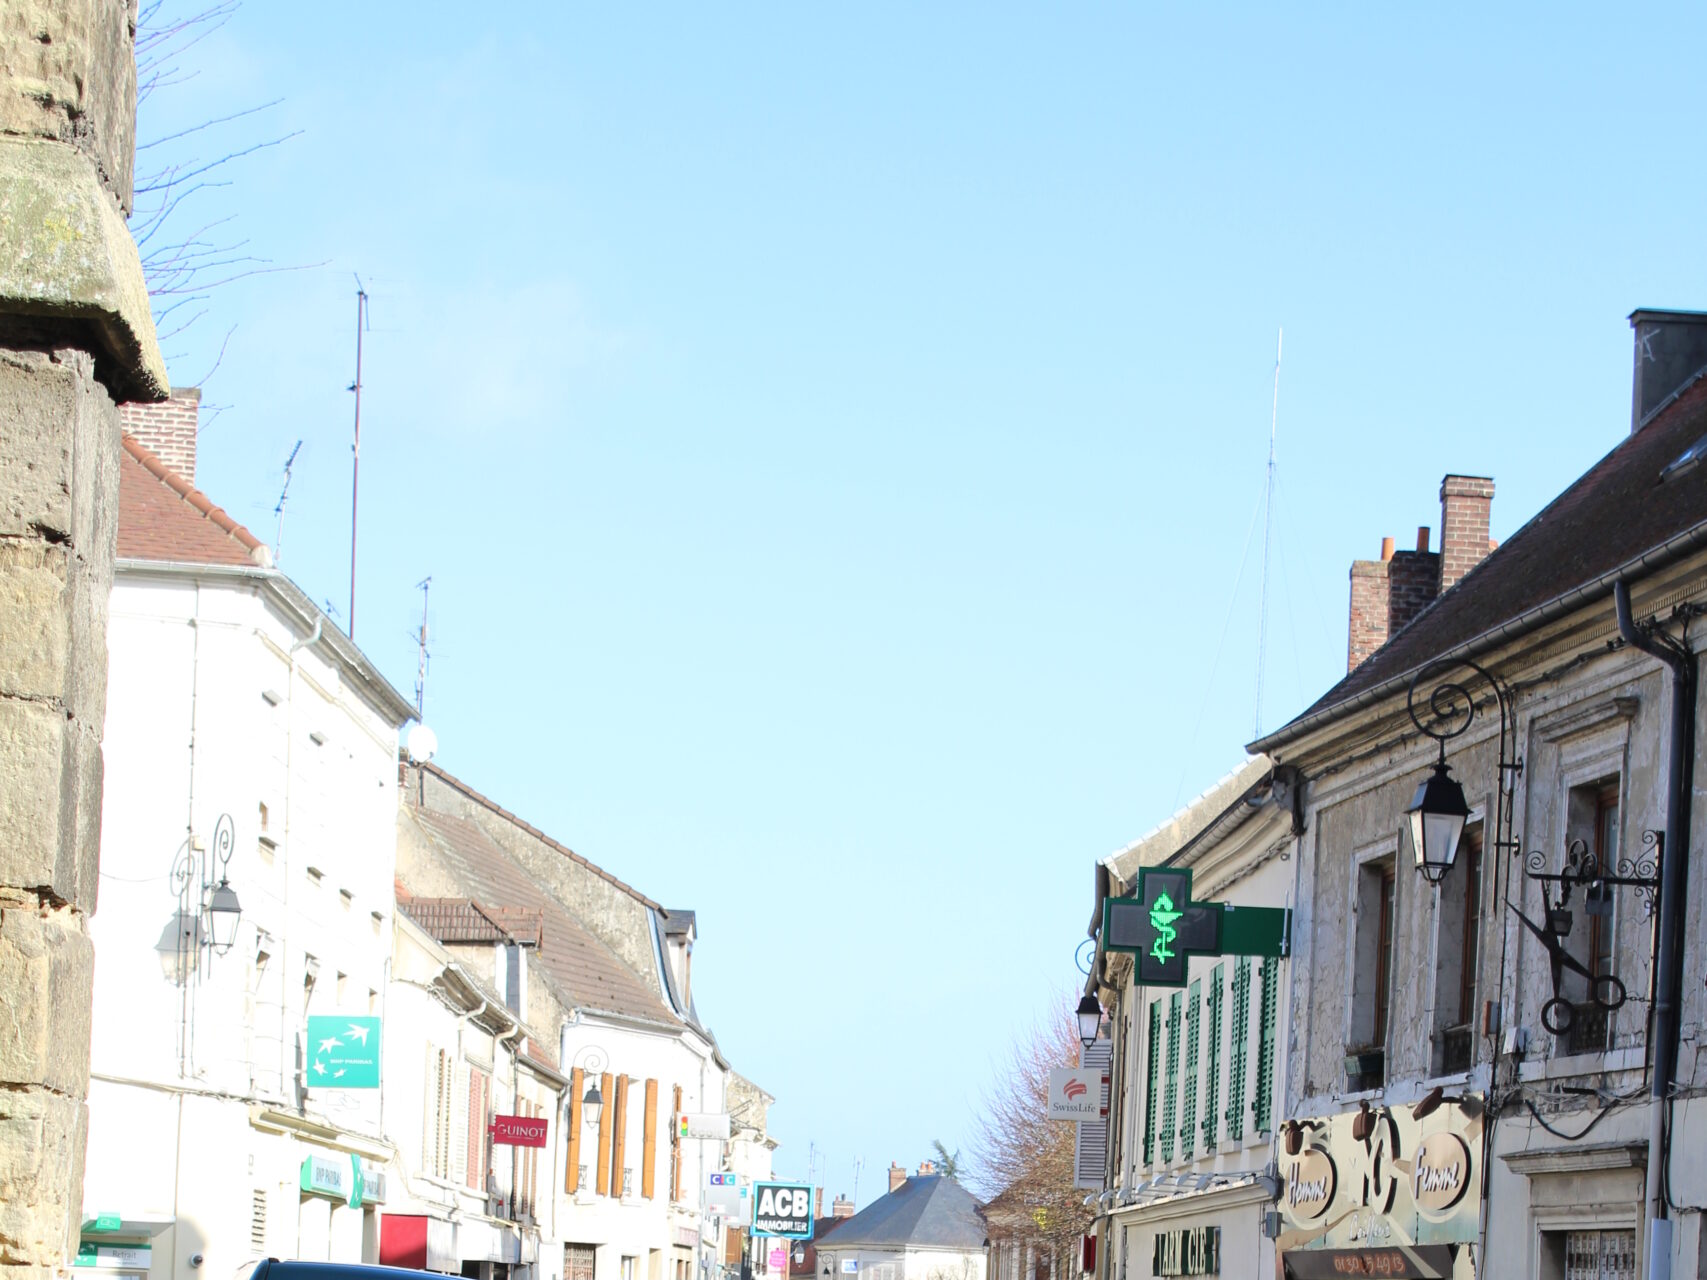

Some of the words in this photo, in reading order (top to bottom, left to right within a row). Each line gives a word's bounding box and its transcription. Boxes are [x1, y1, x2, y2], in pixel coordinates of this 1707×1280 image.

[1053, 1102, 1096, 1113] SwissLife
[497, 1123, 545, 1139] GUINOT
[711, 1174, 735, 1185] CIC
[1414, 1146, 1459, 1199] Femme
[1289, 1162, 1327, 1208] Homme
[757, 1187, 809, 1217] ACB
[756, 1219, 808, 1232] IMMOBILIER
[112, 1249, 137, 1259] Retrait
